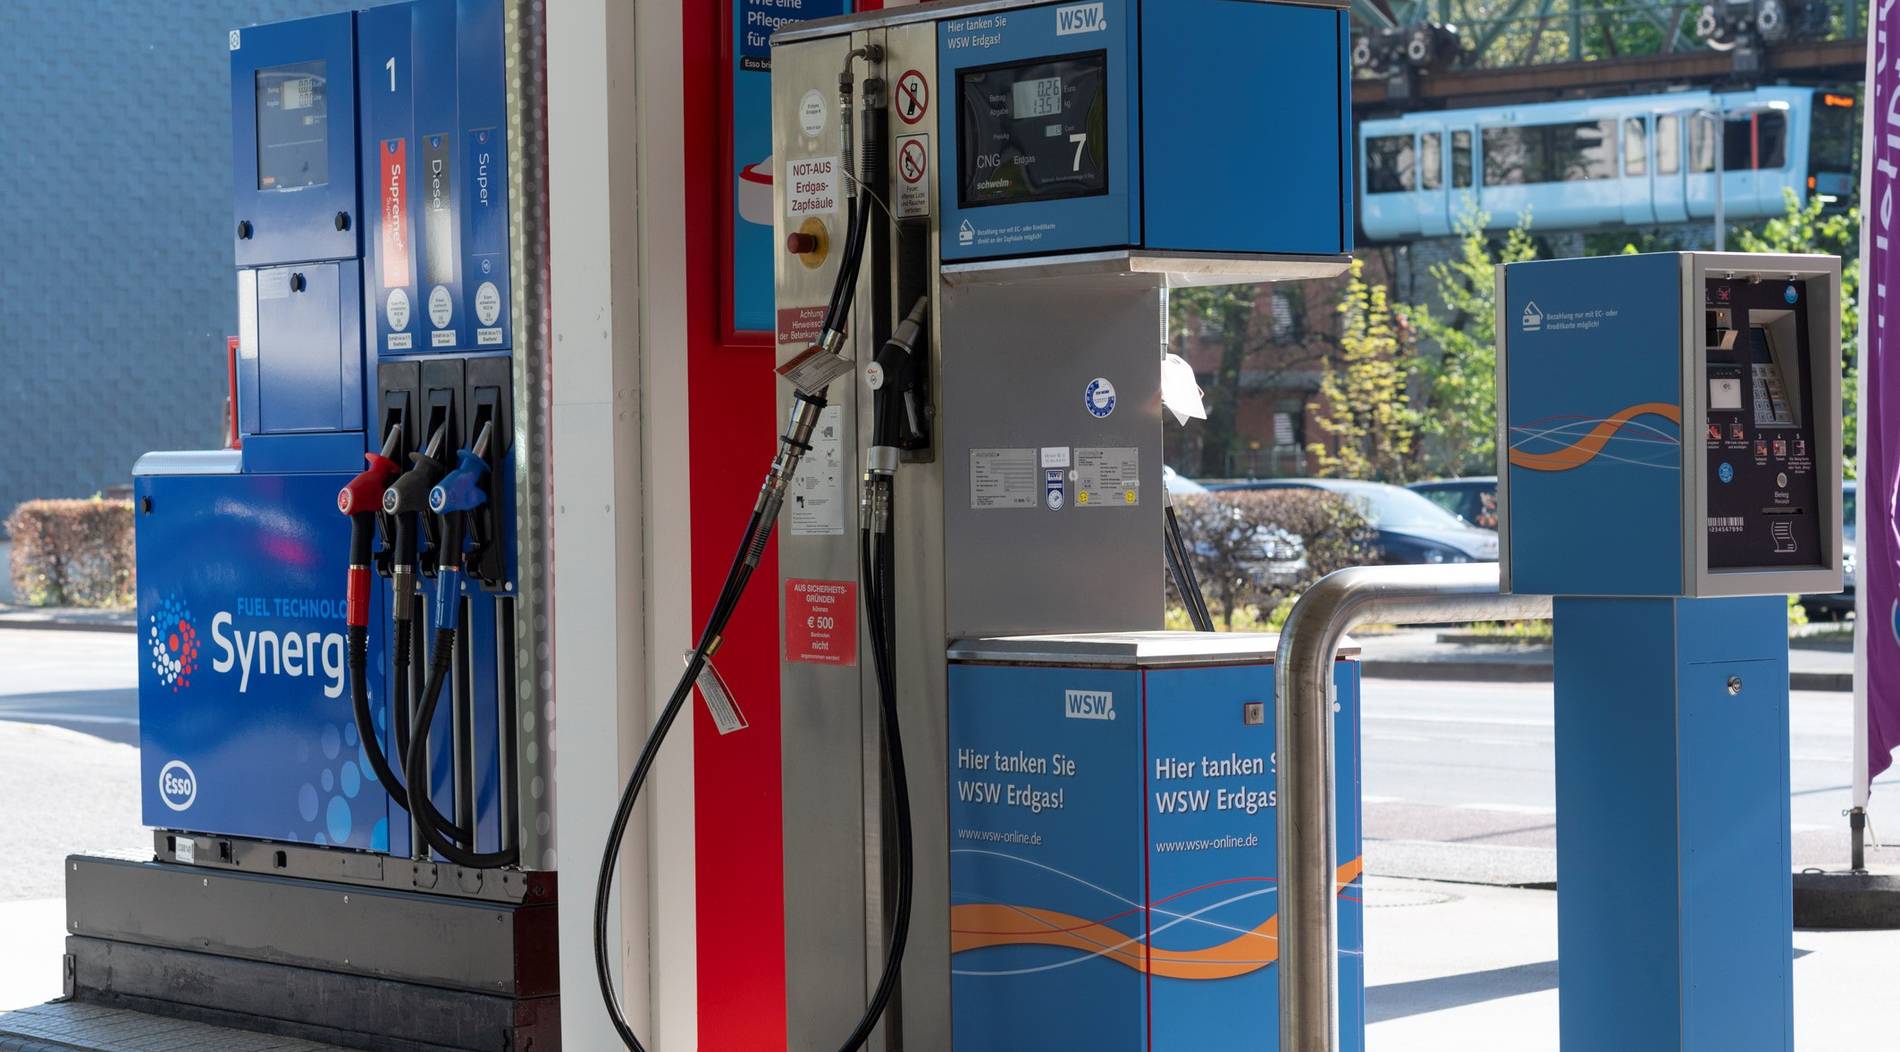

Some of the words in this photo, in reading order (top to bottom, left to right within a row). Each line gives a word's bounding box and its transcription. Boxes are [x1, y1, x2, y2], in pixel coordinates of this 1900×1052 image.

[948, 20, 964, 33] Hier
[966, 18, 993, 32] tanken
[995, 16, 1007, 28] Sie
[747, 31, 766, 47] für
[947, 36, 970, 49] WSW
[972, 34, 1001, 49] Erdgas!
[744, 58, 760, 68] Esso
[386, 56, 396, 92] 1
[1069, 133, 1086, 171] 7
[792, 161, 832, 177] NOT-AUS
[976, 153, 1001, 169] CNG
[477, 152, 490, 207] Super
[796, 181, 829, 195] Erdgas-
[976, 178, 1010, 190] schwelm
[791, 196, 833, 213] Zapfsäule
[1546, 312, 1574, 321] Bezahlung
[1595, 310, 1604, 318] EC-
[1605, 309, 1618, 317] oder
[794, 584, 806, 592] AUS
[806, 584, 848, 594] SICHERHEITS-
[806, 593, 835, 604] GRÜNDEN
[237, 597, 270, 617] FUEL
[273, 598, 348, 619] TECHNOLO
[807, 616, 815, 628] €
[816, 616, 834, 629] 500
[811, 641, 829, 650] nicht
[212, 611, 369, 698] Synerg
[958, 748, 990, 770] Hier
[994, 750, 1047, 774] tanken
[1052, 753, 1076, 776] Sie
[1155, 757, 1196, 780] Hier
[1201, 753, 1264, 777] tanken
[165, 772, 191, 796] Esso
[958, 780, 1001, 804] WSW
[1007, 783, 1064, 813] Erdgas!
[1155, 789, 1209, 814] WSW
[958, 828, 1042, 845] www.wsw-online.de
[1155, 833, 1258, 853] www.wsw-online.de
